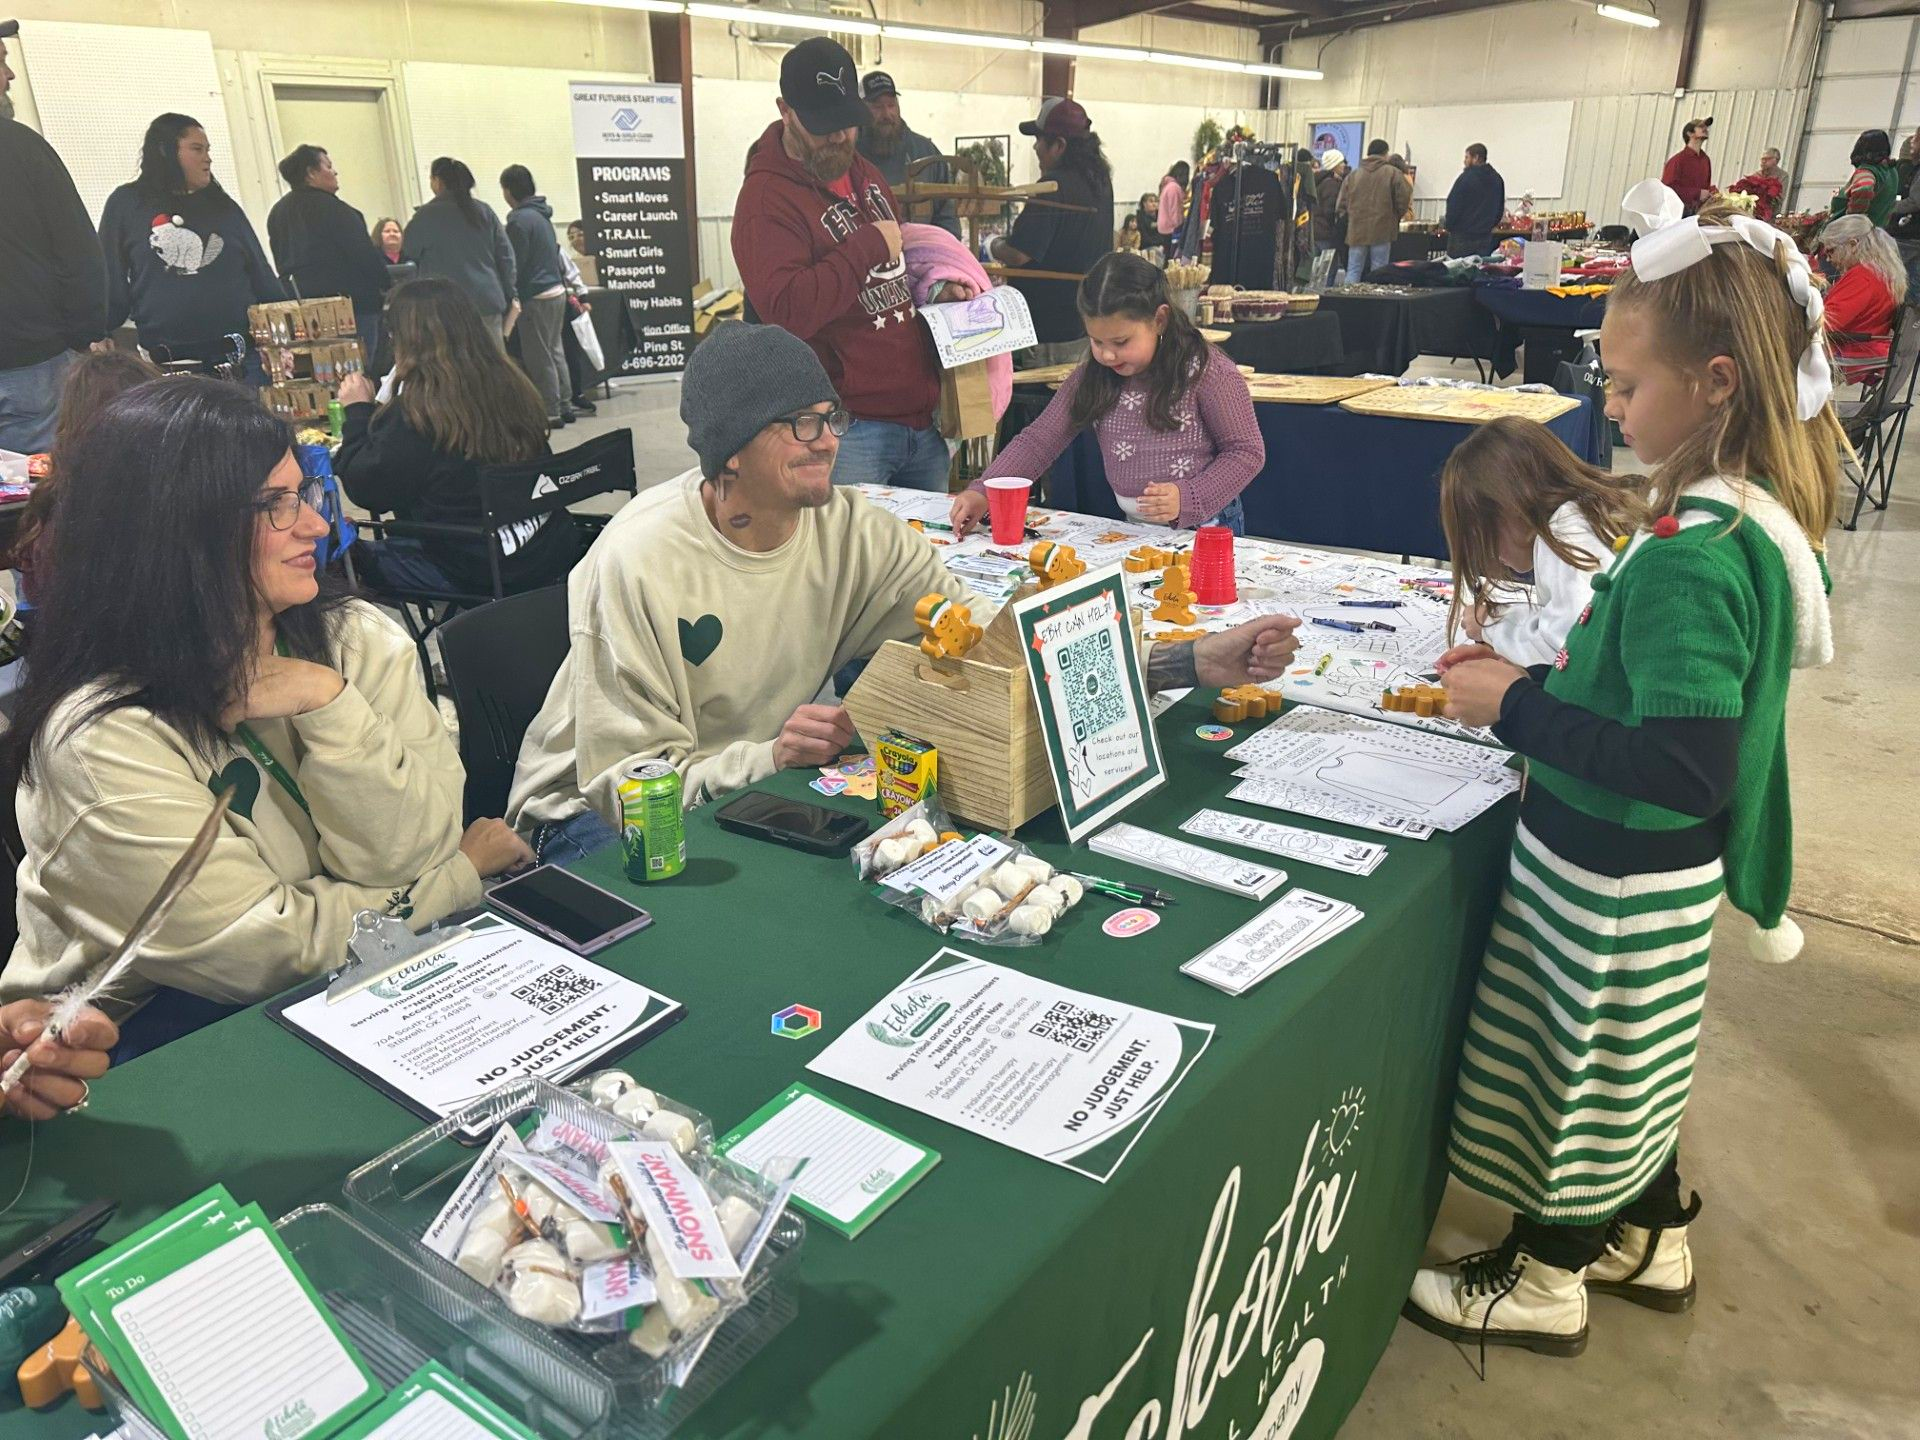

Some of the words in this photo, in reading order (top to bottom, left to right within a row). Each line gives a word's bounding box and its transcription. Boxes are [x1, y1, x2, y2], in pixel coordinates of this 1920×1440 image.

[632, 95, 655, 103] START
[592, 166, 671, 181] PROGRAMS
[601, 192, 633, 204] Smart
[635, 191, 669, 203] Moves
[602, 210, 638, 222] Career
[640, 209, 678, 221] Launch
[604, 228, 651, 240] T.R.A.I.L.
[606, 248, 637, 258] Smart
[639, 246, 663, 258] Girls
[607, 265, 653, 278] Passport
[655, 265, 666, 275] to
[607, 278, 656, 290] Manhood
[629, 298, 648, 311] lthy
[650, 296, 683, 308] Habits
[664, 323, 691, 335] Office
[644, 341, 668, 353] Pine
[670, 340, 685, 351] St.
[559, 472, 582, 485] OZARK
[1041, 622, 1062, 645] EBH
[1066, 614, 1085, 634] CAN
[1092, 733, 1113, 745] Check
[1116, 732, 1128, 742] out
[1129, 731, 1139, 740] our
[883, 746, 915, 765] Crayola
[1096, 750, 1125, 761] locations
[1127, 746, 1138, 756] and
[1104, 762, 1134, 775] services!
[881, 788, 915, 806] CRAYONS
[1236, 919, 1284, 947] Merry
[350, 1005, 389, 1028] Serving
[388, 993, 416, 1009] Tribal
[415, 984, 435, 998] and
[436, 959, 483, 988] Non-Tribal
[482, 938, 523, 962] Members
[402, 992, 454, 1021] Accepting
[452, 974, 487, 998] Clients
[486, 963, 508, 979] Now
[374, 1034, 395, 1048] 704
[394, 1019, 426, 1037] South
[440, 995, 471, 1013] Street
[425, 1019, 442, 1031] OK
[882, 991, 933, 1033] Echota
[400, 1034, 447, 1060] Individual
[445, 1014, 483, 1038] Therapy
[413, 1053, 440, 1068] Case
[439, 1020, 499, 1055] Management
[420, 1053, 451, 1071] School
[451, 1040, 478, 1057] Based
[478, 1016, 518, 1041] Therapy
[886, 1057, 917, 1082] Serving
[911, 1039, 932, 1060] Tribal
[930, 1027, 944, 1042] and
[942, 1000, 974, 1030] Non-Tribal
[972, 976, 1000, 1001] Members
[934, 1035, 972, 1070] Accepting
[966, 1014, 991, 1037] Clients
[987, 1002, 1004, 1019] Now
[407, 1044, 439, 1064] Family
[438, 1025, 476, 1049] Therapy
[427, 1047, 478, 1077] Medication
[477, 1013, 537, 1051] Management
[476, 1066, 508, 1086] NO
[510, 1003, 618, 1068] JUDGEMENT.
[521, 1048, 563, 1075] JUST
[563, 1024, 610, 1050] HELP.
[925, 1085, 943, 1100] 704
[941, 1065, 962, 1088] South
[968, 1037, 991, 1058] Street
[964, 1061, 980, 1076] OK
[996, 1069, 1021, 1094] Therapy
[1032, 1056, 1058, 1083] Therapy
[963, 1080, 995, 1111] Individual
[993, 1057, 1019, 1083] Therapy
[985, 1101, 1001, 1119] Case
[1000, 1061, 1040, 1102] Management
[1006, 1089, 1041, 1127] Medication
[1038, 1051, 1075, 1092] Management
[1063, 1109, 1089, 1133] NO
[1083, 1038, 1151, 1111] JUDGEMENT.
[1103, 1087, 1135, 1121] JUST
[1125, 1059, 1160, 1090] HELP.
[729, 1133, 742, 1144] Do
[432, 1202, 460, 1239] Everything
[458, 1190, 469, 1208] you
[467, 1176, 479, 1194] need
[641, 1152, 713, 1262] SNOWMAN?
[106, 1284, 126, 1301] To
[125, 1272, 146, 1290] Do
[1257, 1254, 1350, 1406] HEALTH
[1265, 1370, 1306, 1440] pany
